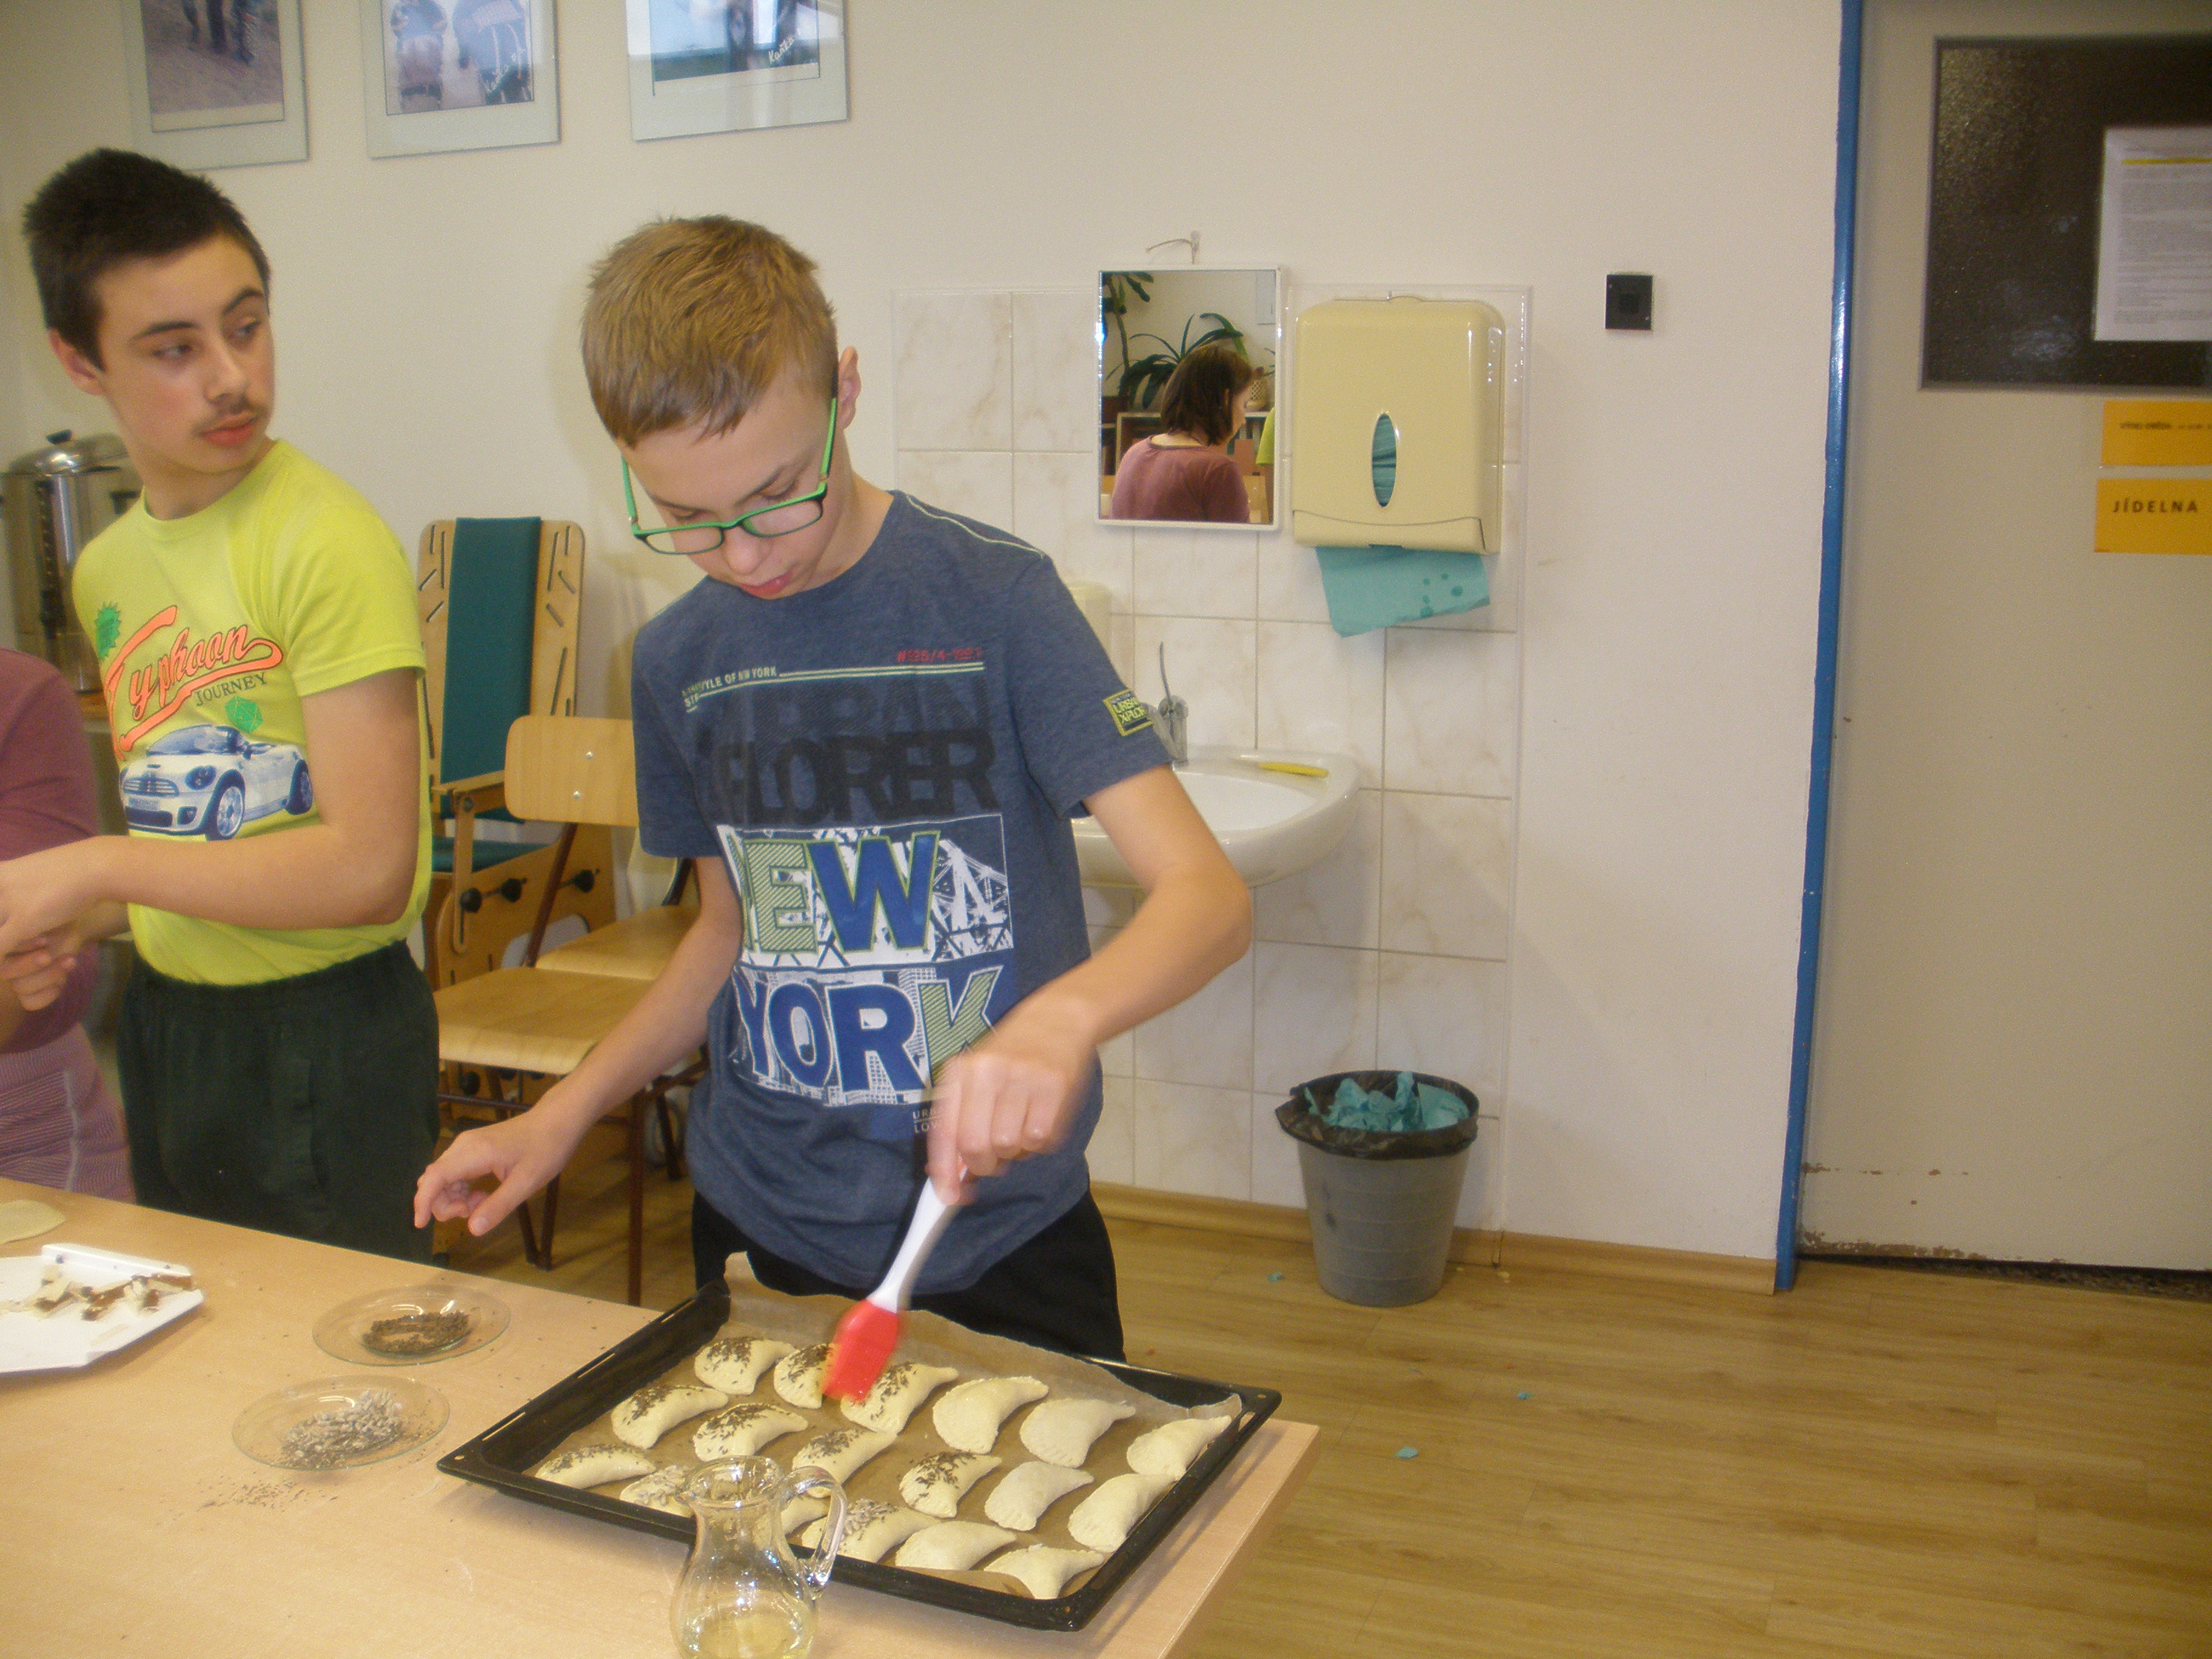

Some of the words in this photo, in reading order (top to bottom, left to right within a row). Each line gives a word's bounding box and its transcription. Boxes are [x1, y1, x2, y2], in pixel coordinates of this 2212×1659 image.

[2113, 497, 2198, 514] JÍDELNA
[104, 605, 284, 762] Typhoon
[196, 671, 269, 706] JOURNEY
[724, 672, 736, 685] OF
[751, 666, 777, 679] YORK
[731, 965, 1004, 1091] YORK
